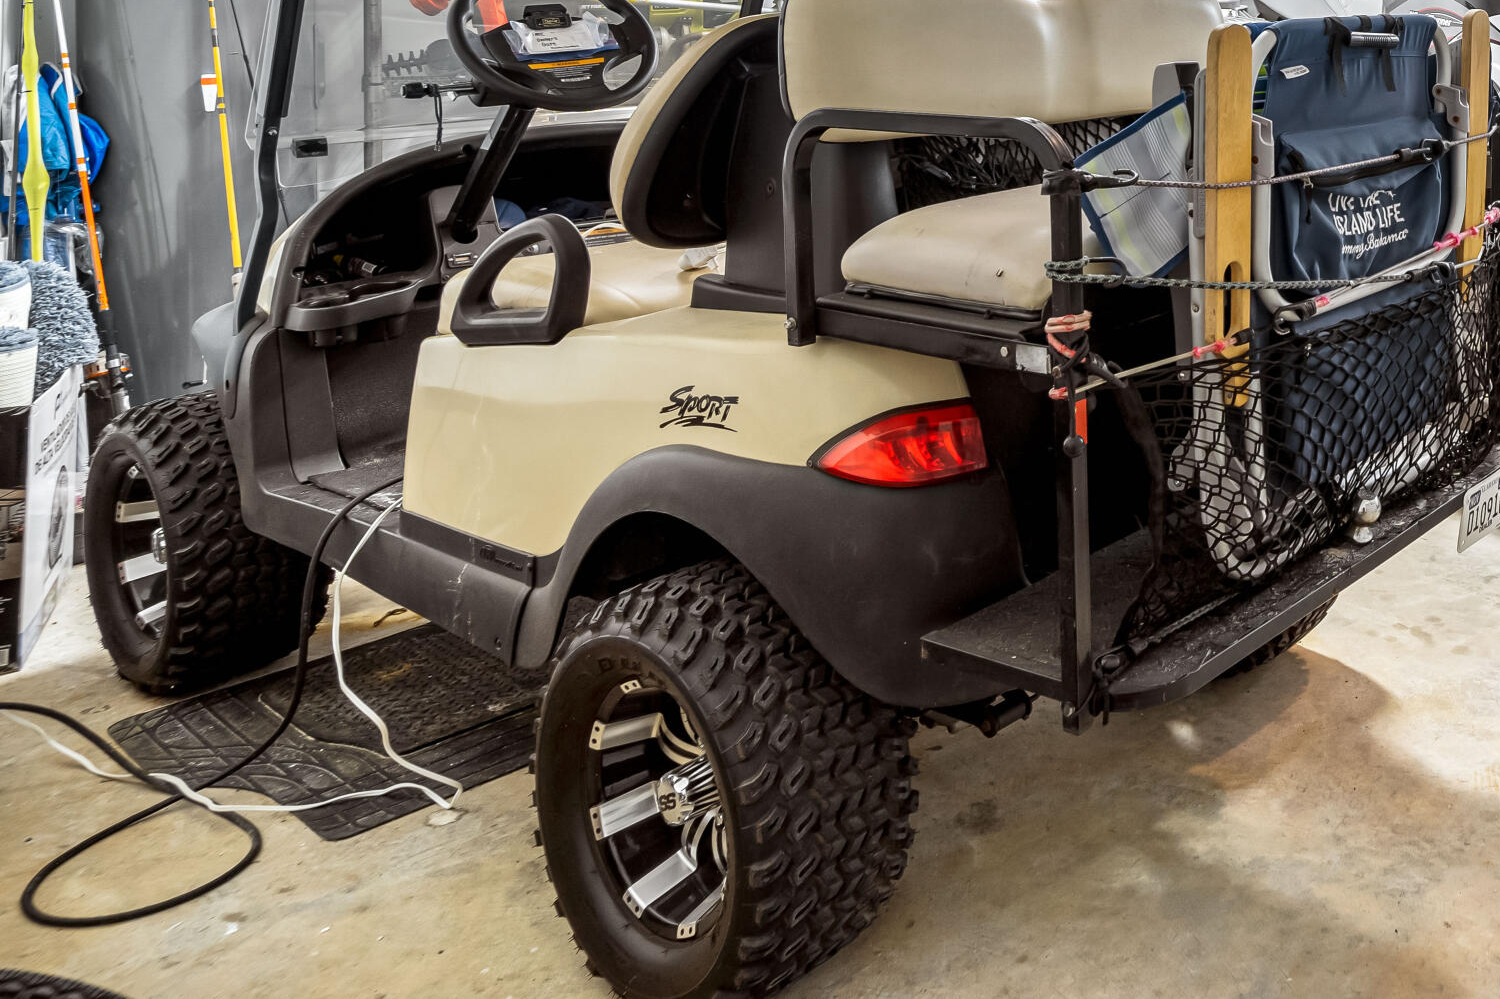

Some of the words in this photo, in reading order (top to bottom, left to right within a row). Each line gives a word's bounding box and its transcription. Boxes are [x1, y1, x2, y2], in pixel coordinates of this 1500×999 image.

[1333, 210, 1376, 236] ISLAND
[1376, 202, 1405, 229] LIFE
[1342, 241, 1366, 260] mmy
[1364, 228, 1409, 251] Bahama
[659, 792, 677, 812] SS
